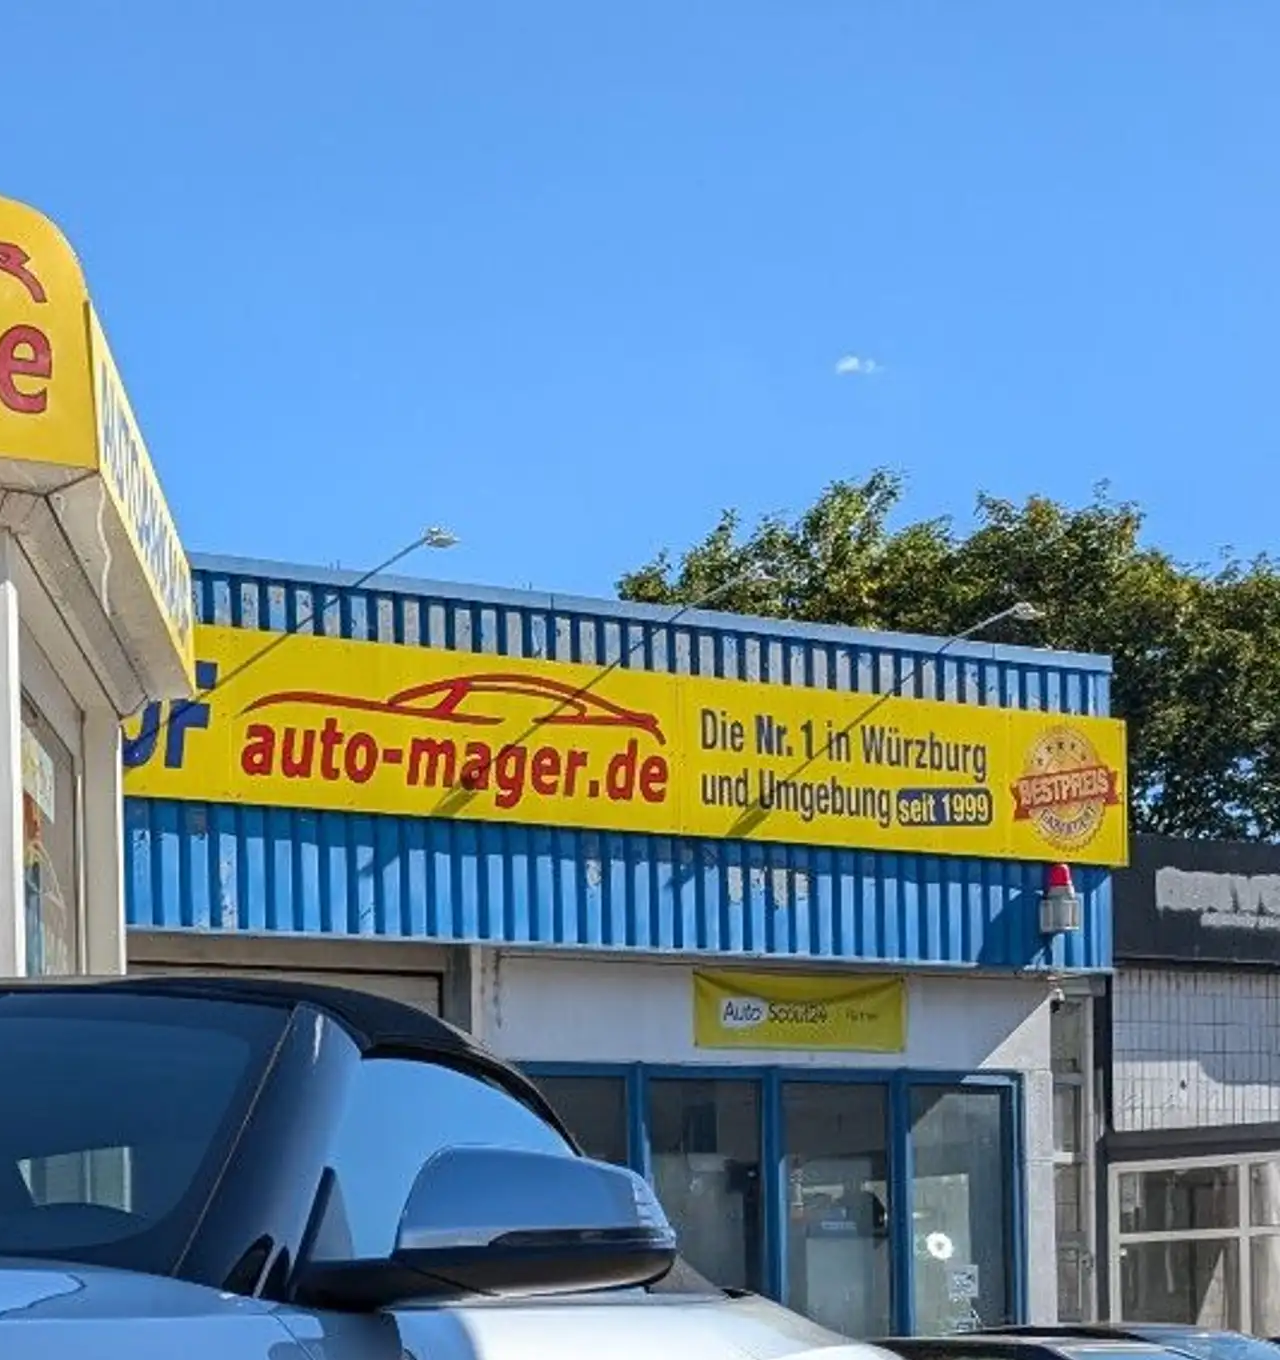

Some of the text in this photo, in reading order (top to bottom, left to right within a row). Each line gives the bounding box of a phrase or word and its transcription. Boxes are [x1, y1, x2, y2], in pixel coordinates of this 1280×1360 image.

[241, 717, 669, 809] auto-mager.de
[701, 709, 987, 781] Die Nr. 1 in Würzburg
[701, 768, 988, 828] und Umgebung seit 1999
[723, 1000, 763, 1021] Auto
